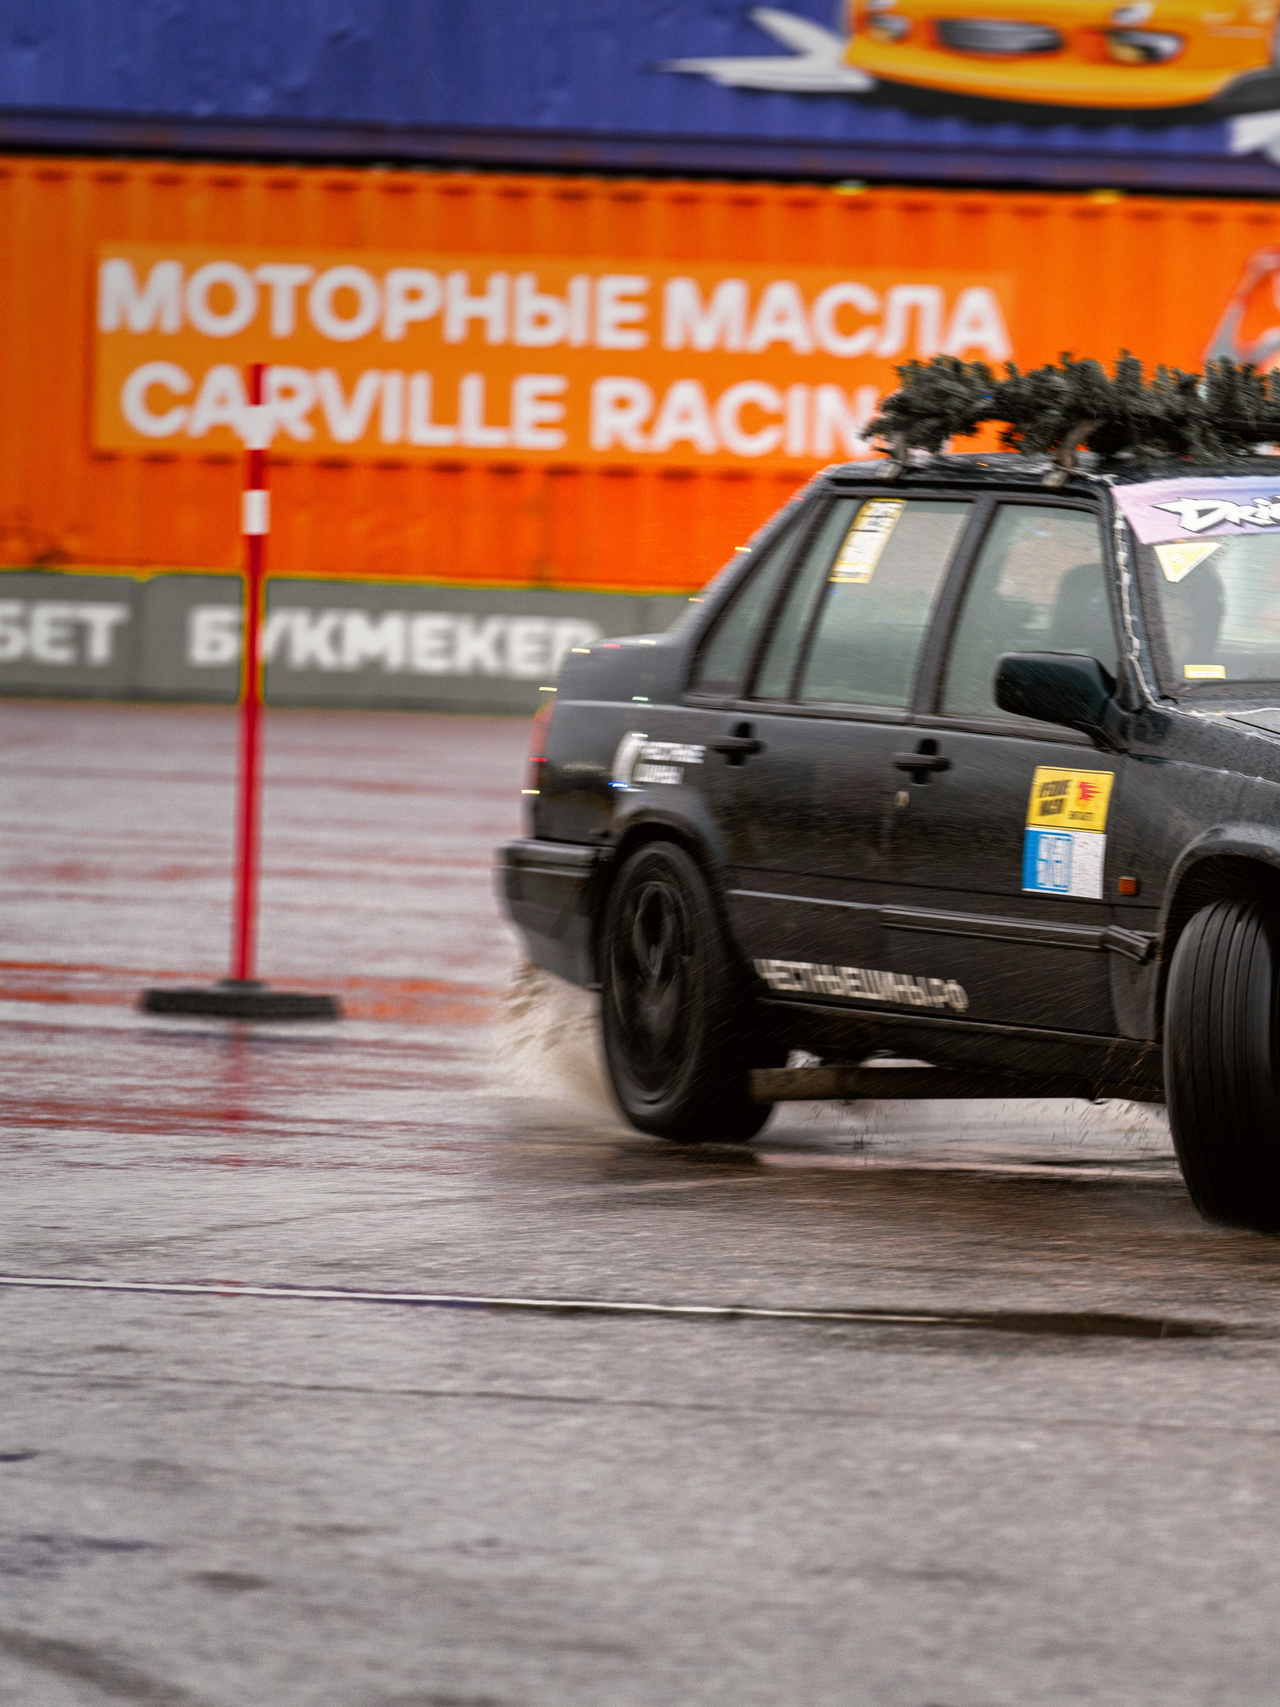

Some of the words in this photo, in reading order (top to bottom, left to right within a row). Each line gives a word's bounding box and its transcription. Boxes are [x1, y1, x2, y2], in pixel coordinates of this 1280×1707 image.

[98, 257, 651, 352] МОТОРНЫЕ
[661, 268, 1014, 363] МАСЛА
[120, 359, 570, 451] CARVILLE
[588, 373, 952, 460] RACIN
